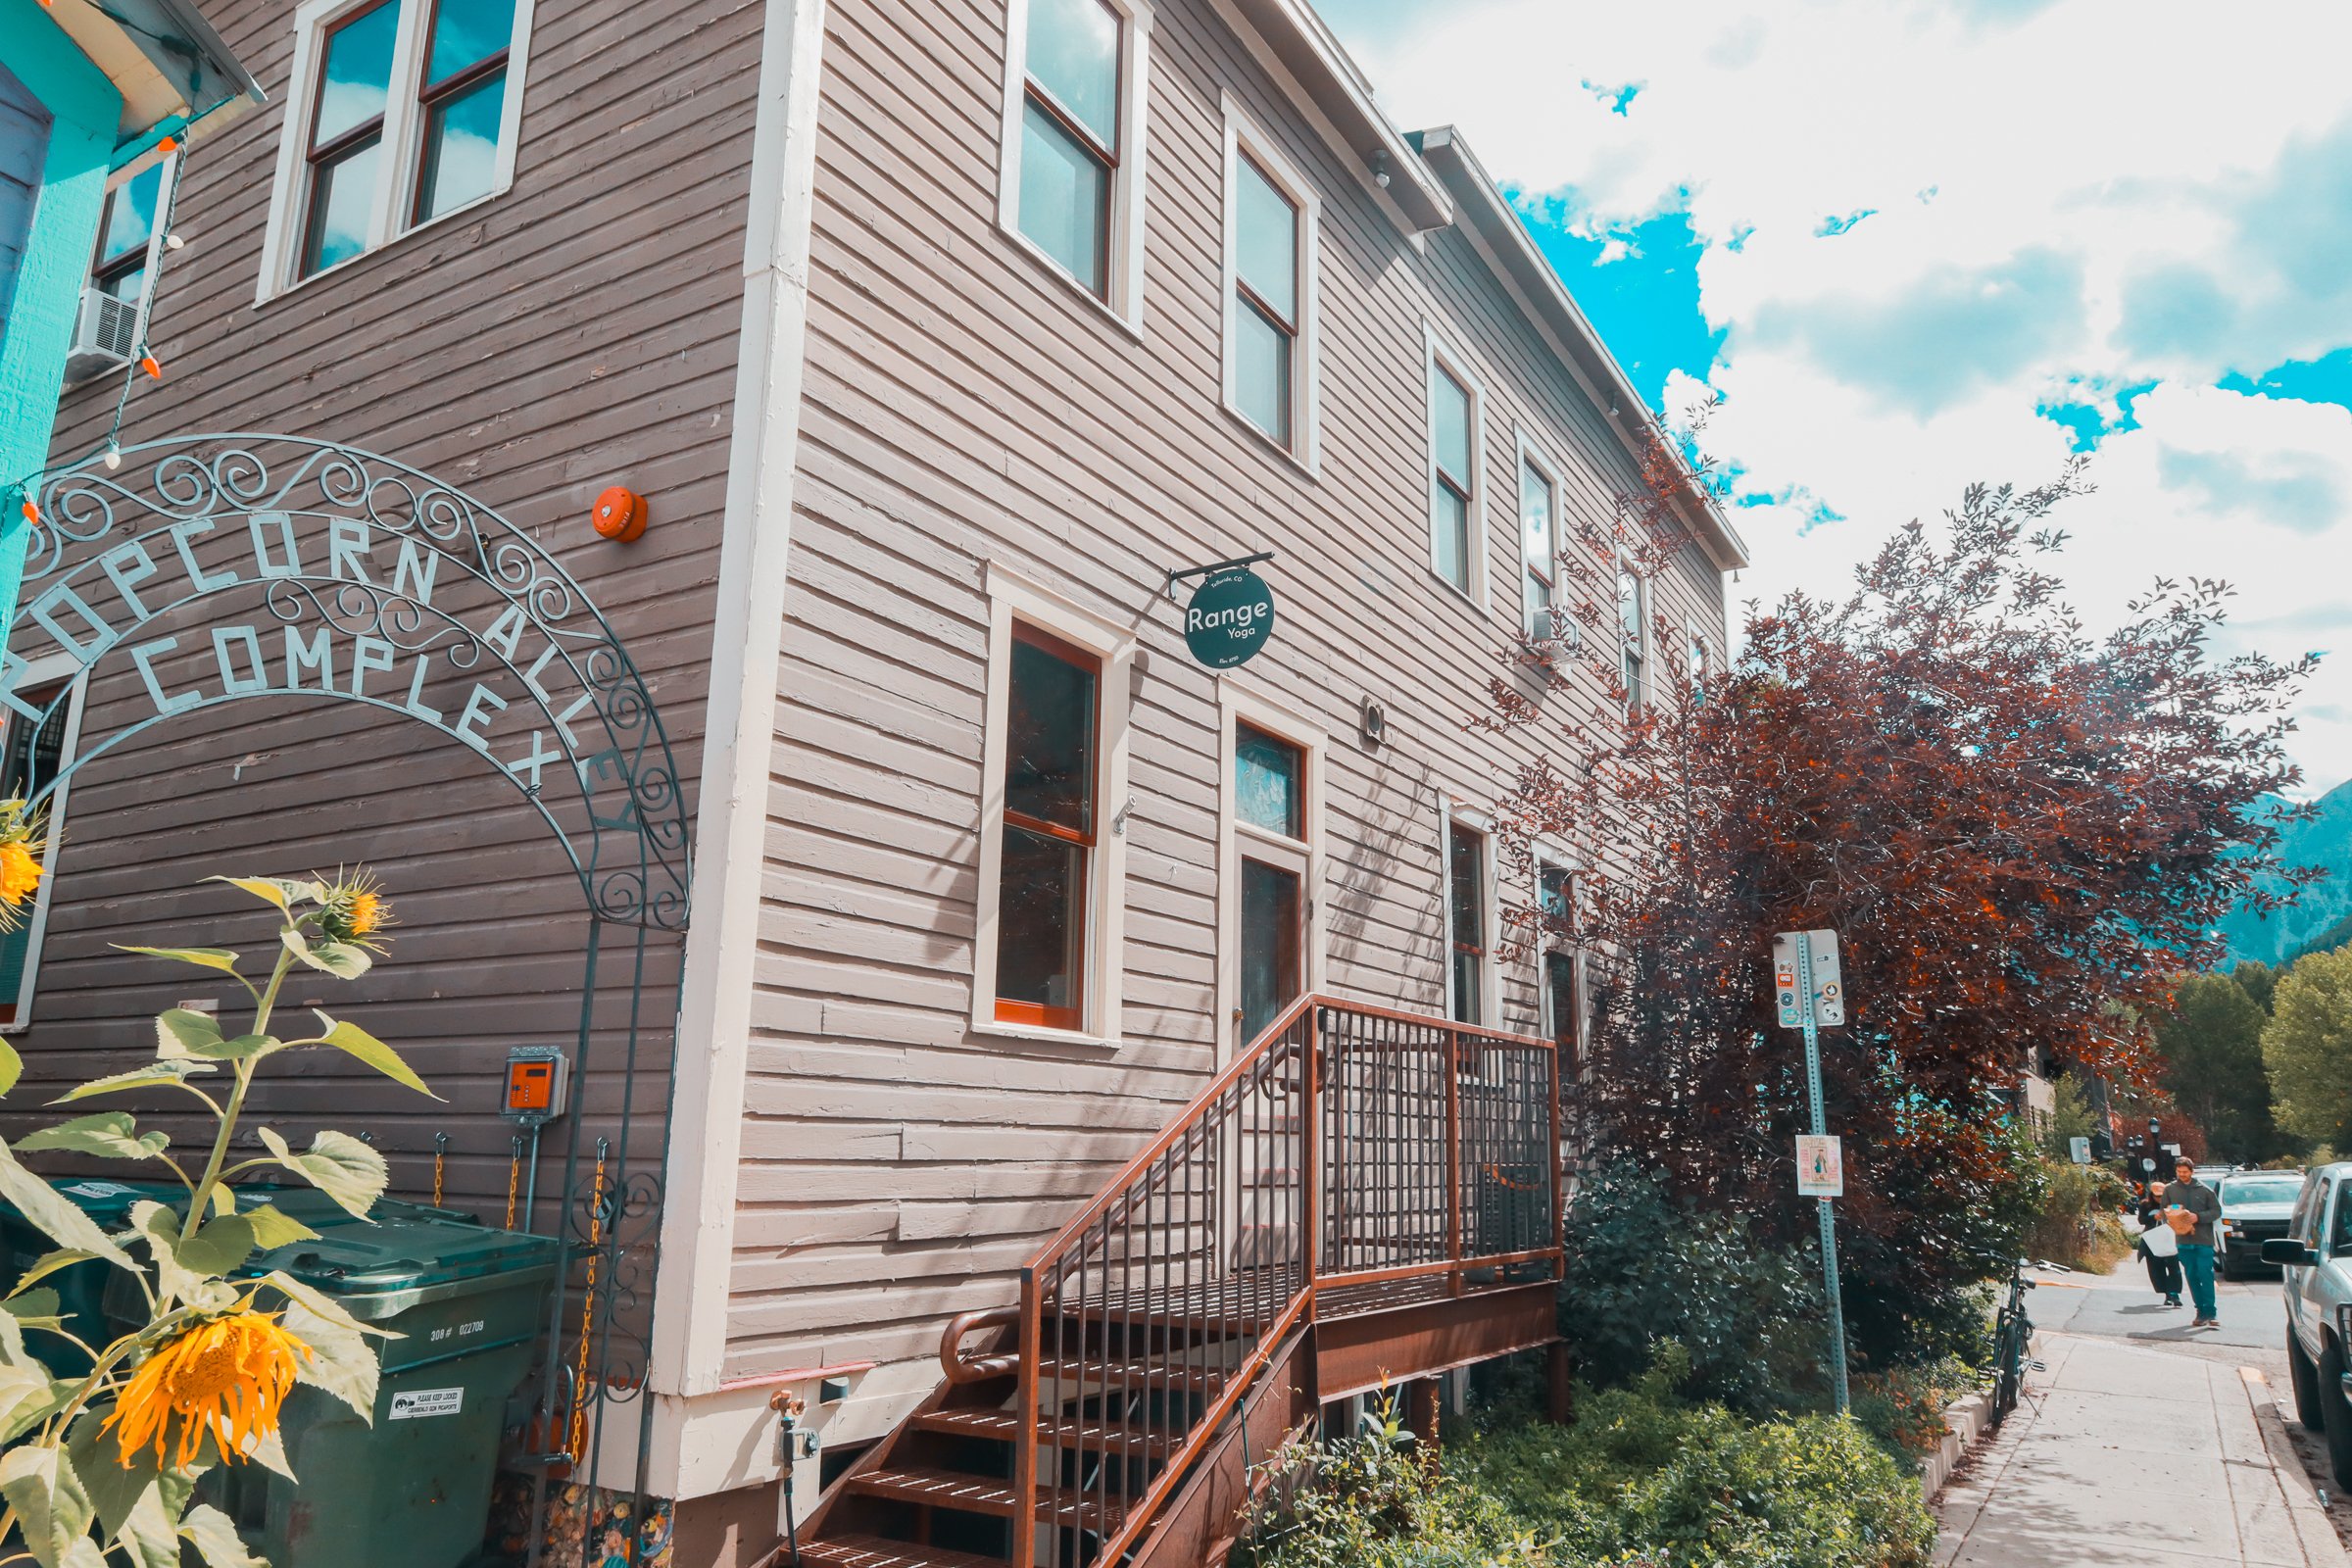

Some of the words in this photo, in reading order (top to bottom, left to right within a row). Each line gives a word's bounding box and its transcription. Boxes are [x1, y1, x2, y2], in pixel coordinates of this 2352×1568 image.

[1189, 602, 1269, 633] Range
[1227, 627, 1255, 639] Yoga
[0, 512, 439, 723] POPCORN
[482, 604, 642, 832] ALLEY
[130, 624, 562, 799] COMPLEX
[460, 1320, 484, 1336] 022709
[432, 1393, 442, 1401] KEEP
